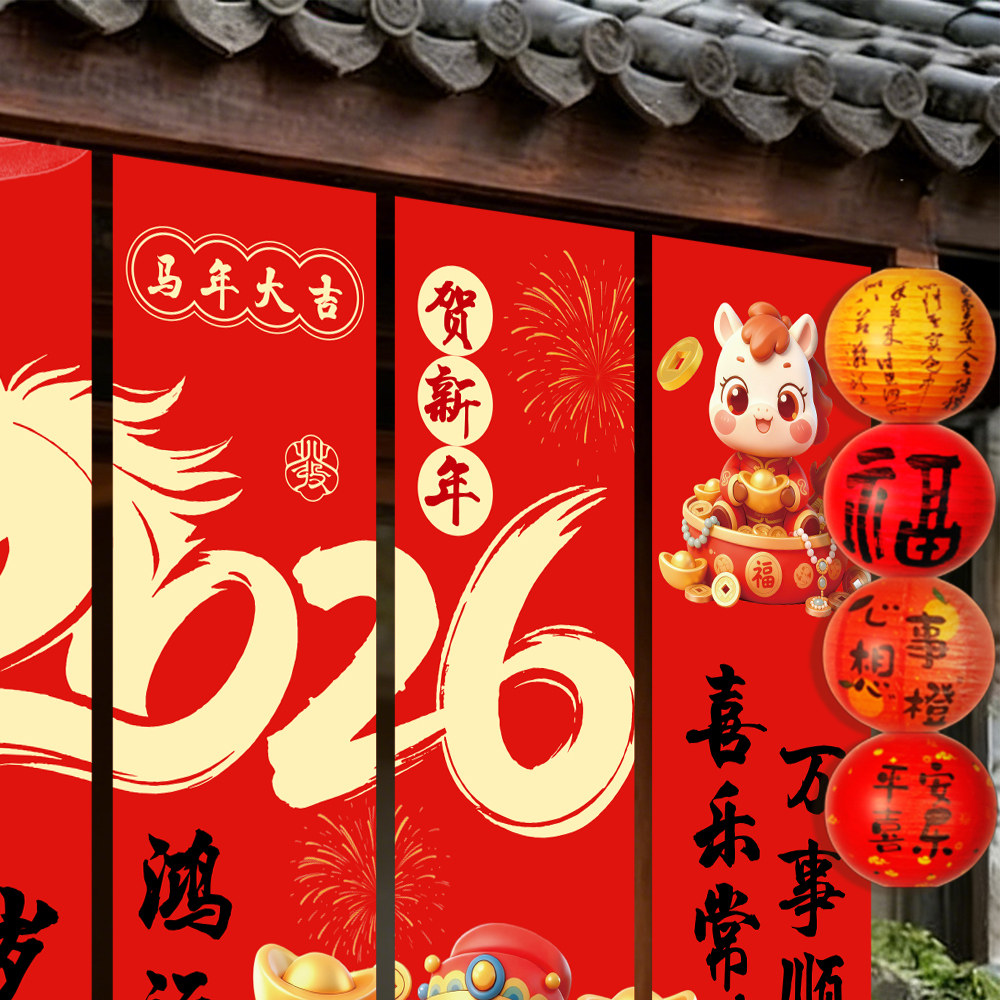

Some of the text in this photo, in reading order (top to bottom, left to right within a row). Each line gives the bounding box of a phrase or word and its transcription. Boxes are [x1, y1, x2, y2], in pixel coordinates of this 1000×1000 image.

[147, 253, 342, 321] 马年大吉
[425, 280, 481, 526] 贺新年
[843, 447, 962, 567] 福
[752, 560, 775, 589] 福
